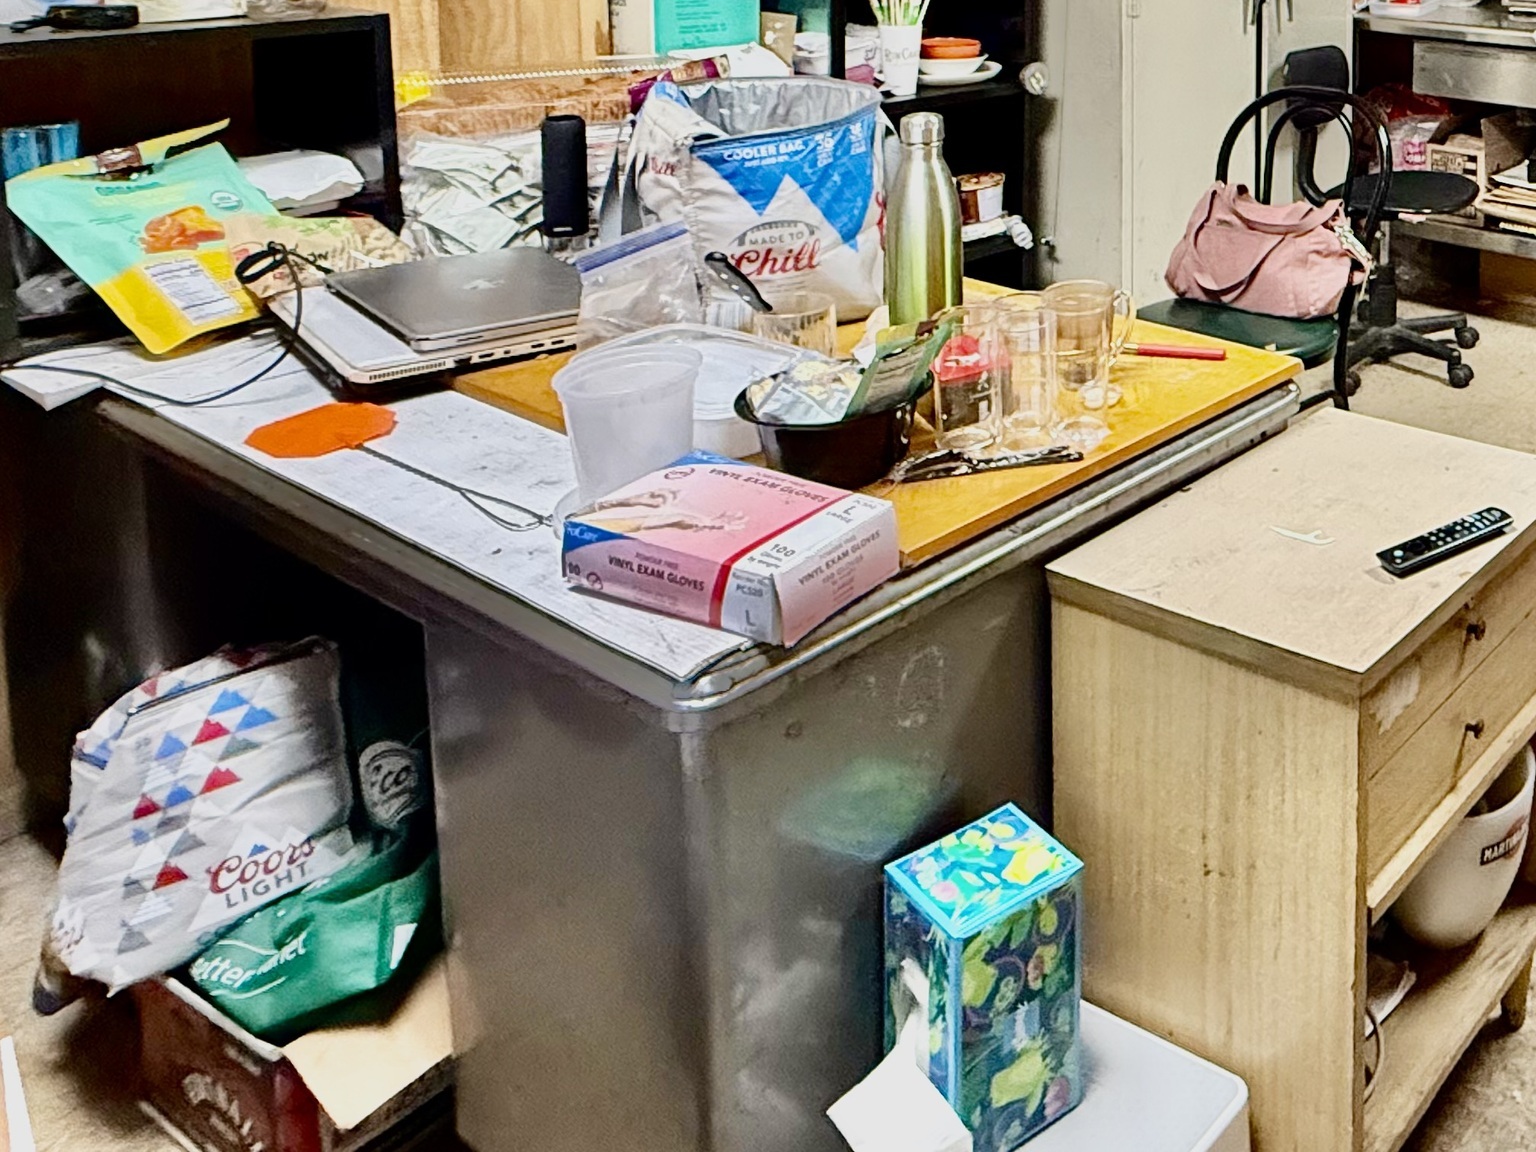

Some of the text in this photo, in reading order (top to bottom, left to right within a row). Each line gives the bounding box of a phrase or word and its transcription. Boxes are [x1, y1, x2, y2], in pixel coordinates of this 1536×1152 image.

[723, 140, 806, 161] COOLER BAG
[730, 238, 822, 278] Chill
[749, 231, 805, 247] MADE TO
[608, 555, 706, 592] VINYL EXAM GLOVES
[798, 566, 826, 586] VINYL
[825, 548, 850, 570] EXAM
[850, 529, 882, 555] GLOVES
[205, 835, 316, 895] Coors
[224, 860, 310, 909] LIGHT
